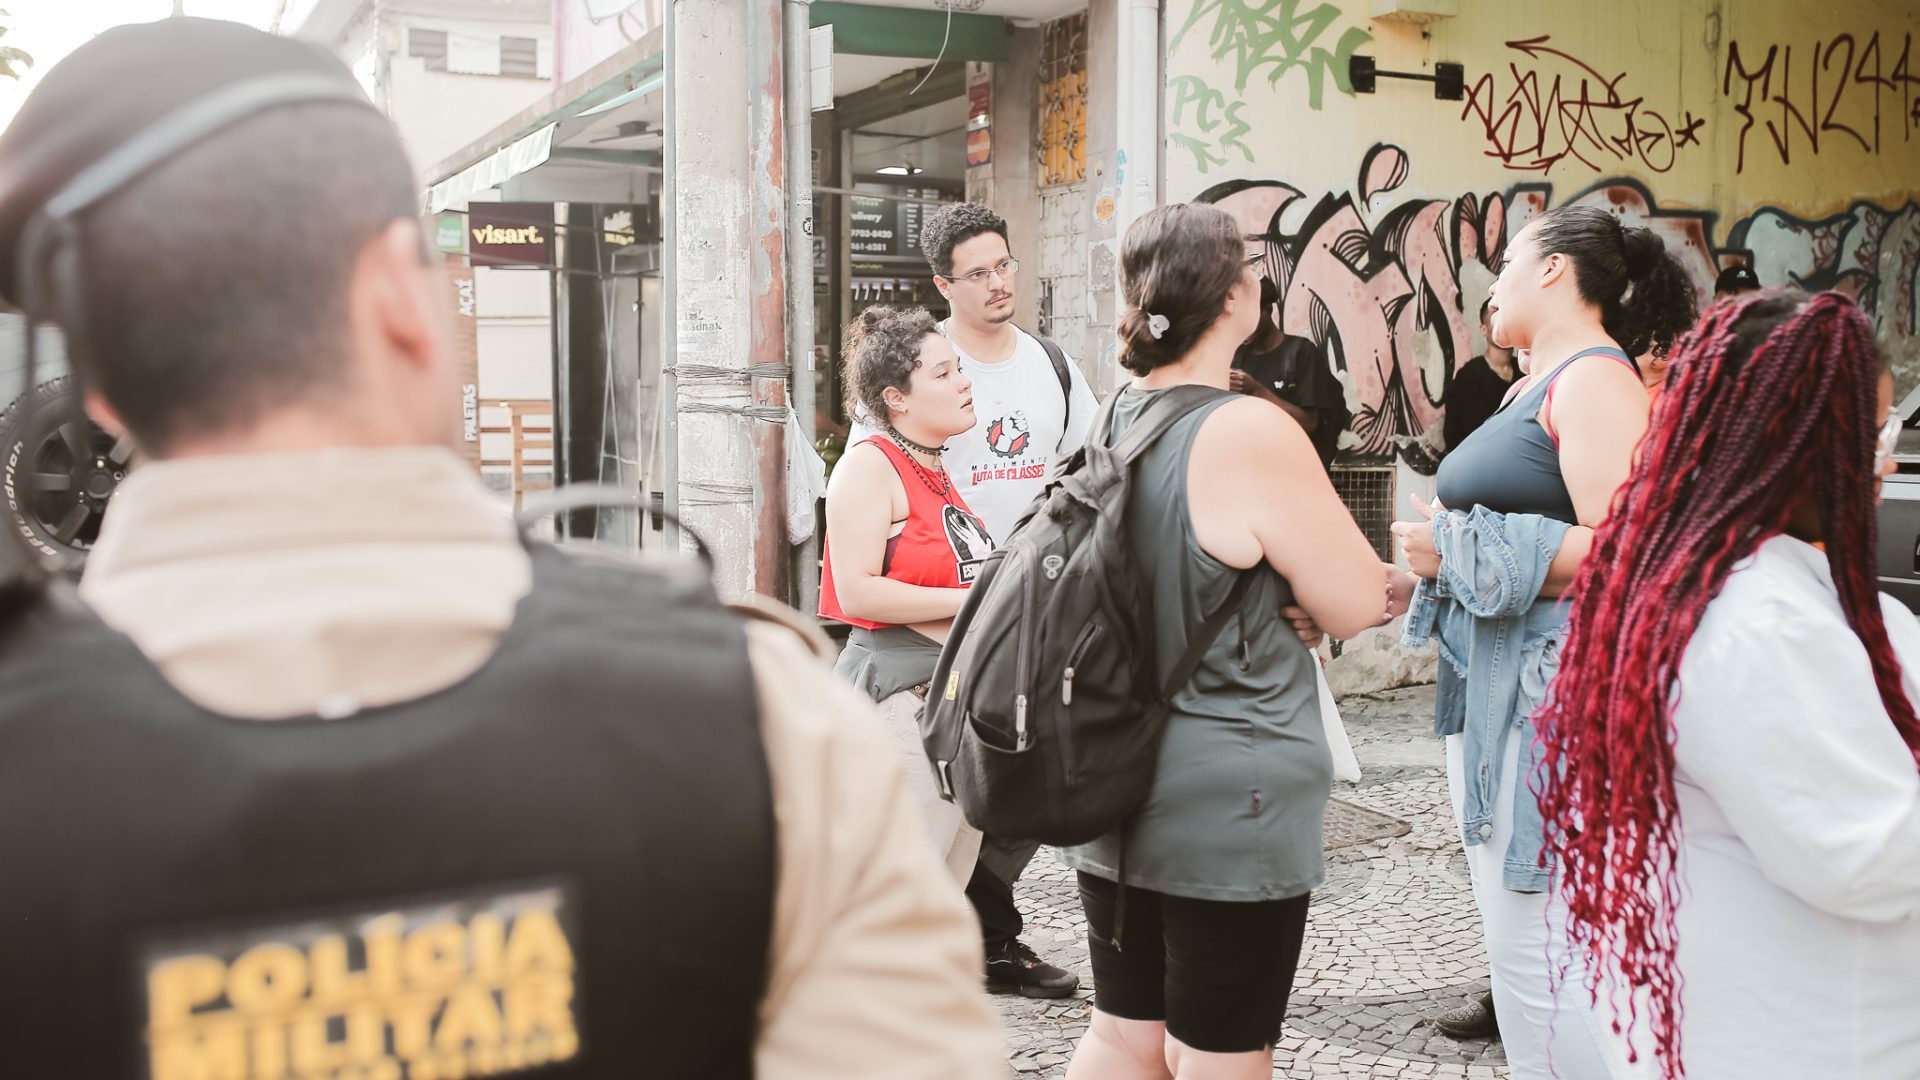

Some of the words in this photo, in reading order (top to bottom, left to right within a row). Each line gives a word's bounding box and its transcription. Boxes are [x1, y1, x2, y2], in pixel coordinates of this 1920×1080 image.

[472, 223, 545, 245] visart.
[454, 278, 475, 317] AÇAÍ
[463, 383, 478, 443] PALETAS
[971, 456, 1047, 472] MOVIMENTO
[972, 470, 993, 486] LUTA
[994, 469, 1006, 480] DE
[1007, 463, 1046, 481] CLASSES
